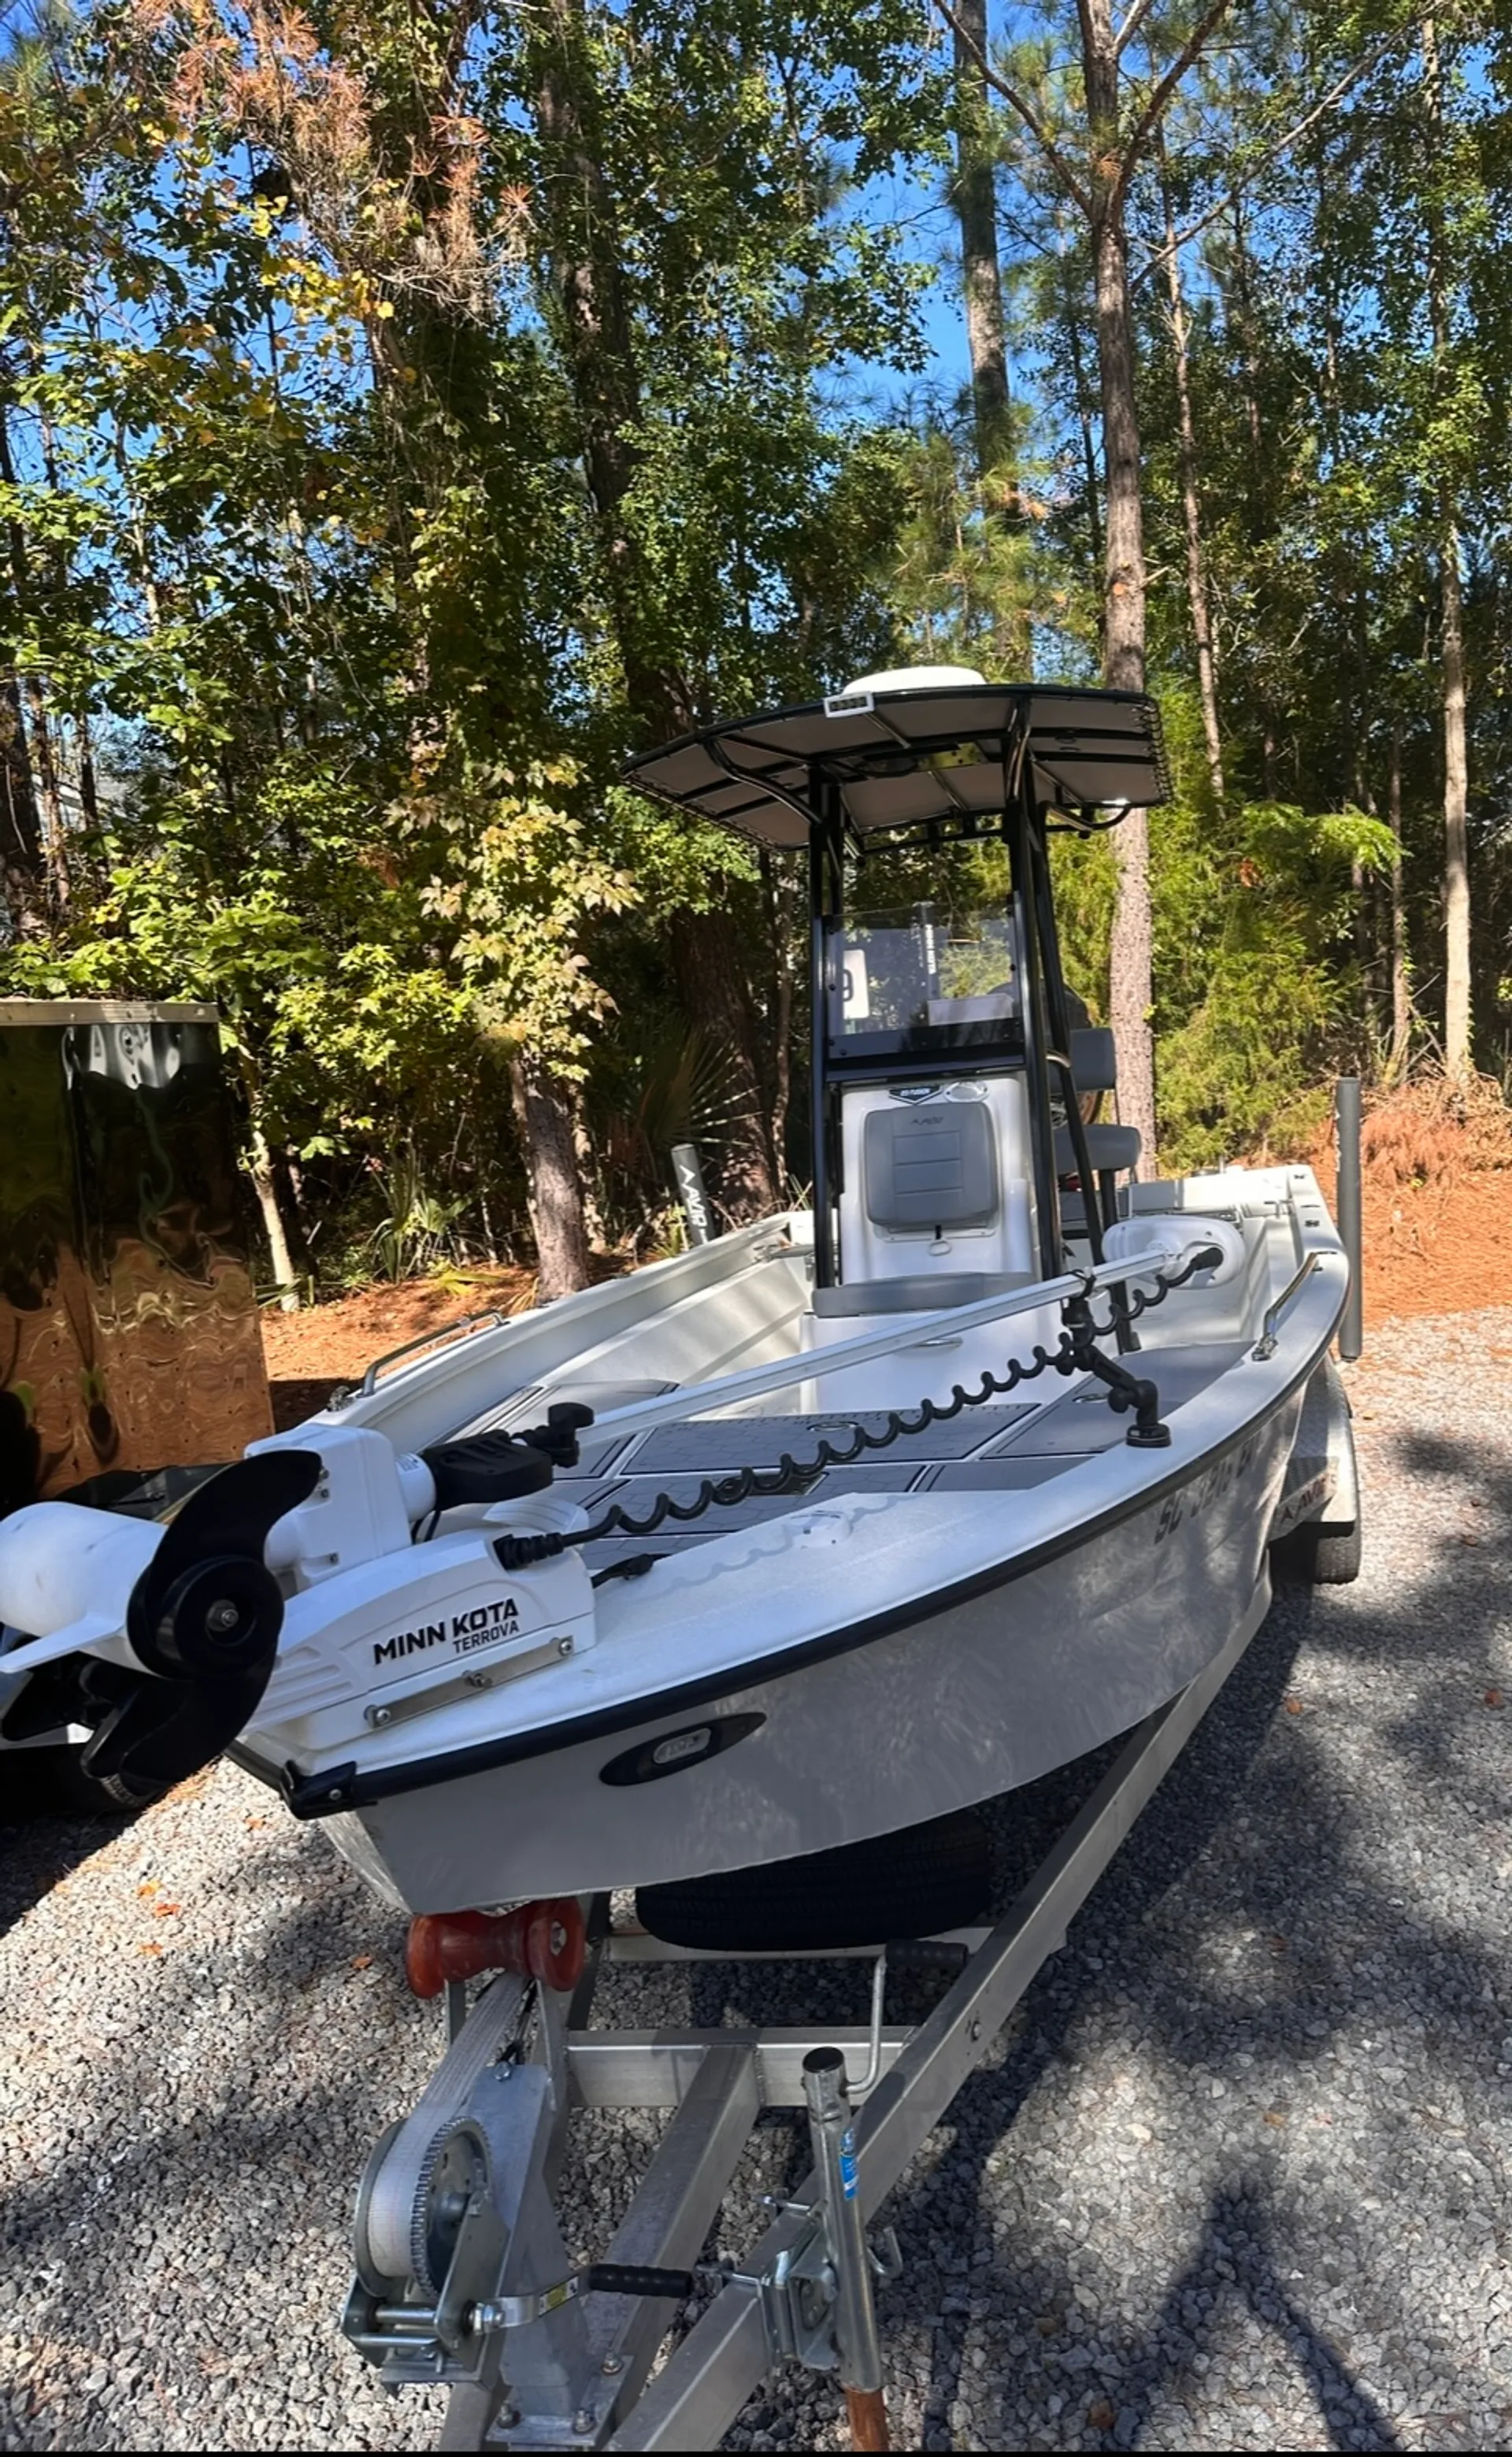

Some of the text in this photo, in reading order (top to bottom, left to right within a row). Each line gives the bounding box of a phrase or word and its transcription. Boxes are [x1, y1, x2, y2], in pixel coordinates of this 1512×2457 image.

[372, 1598, 520, 1666] MINN KOTA
[452, 1619, 520, 1655] TERROVA
